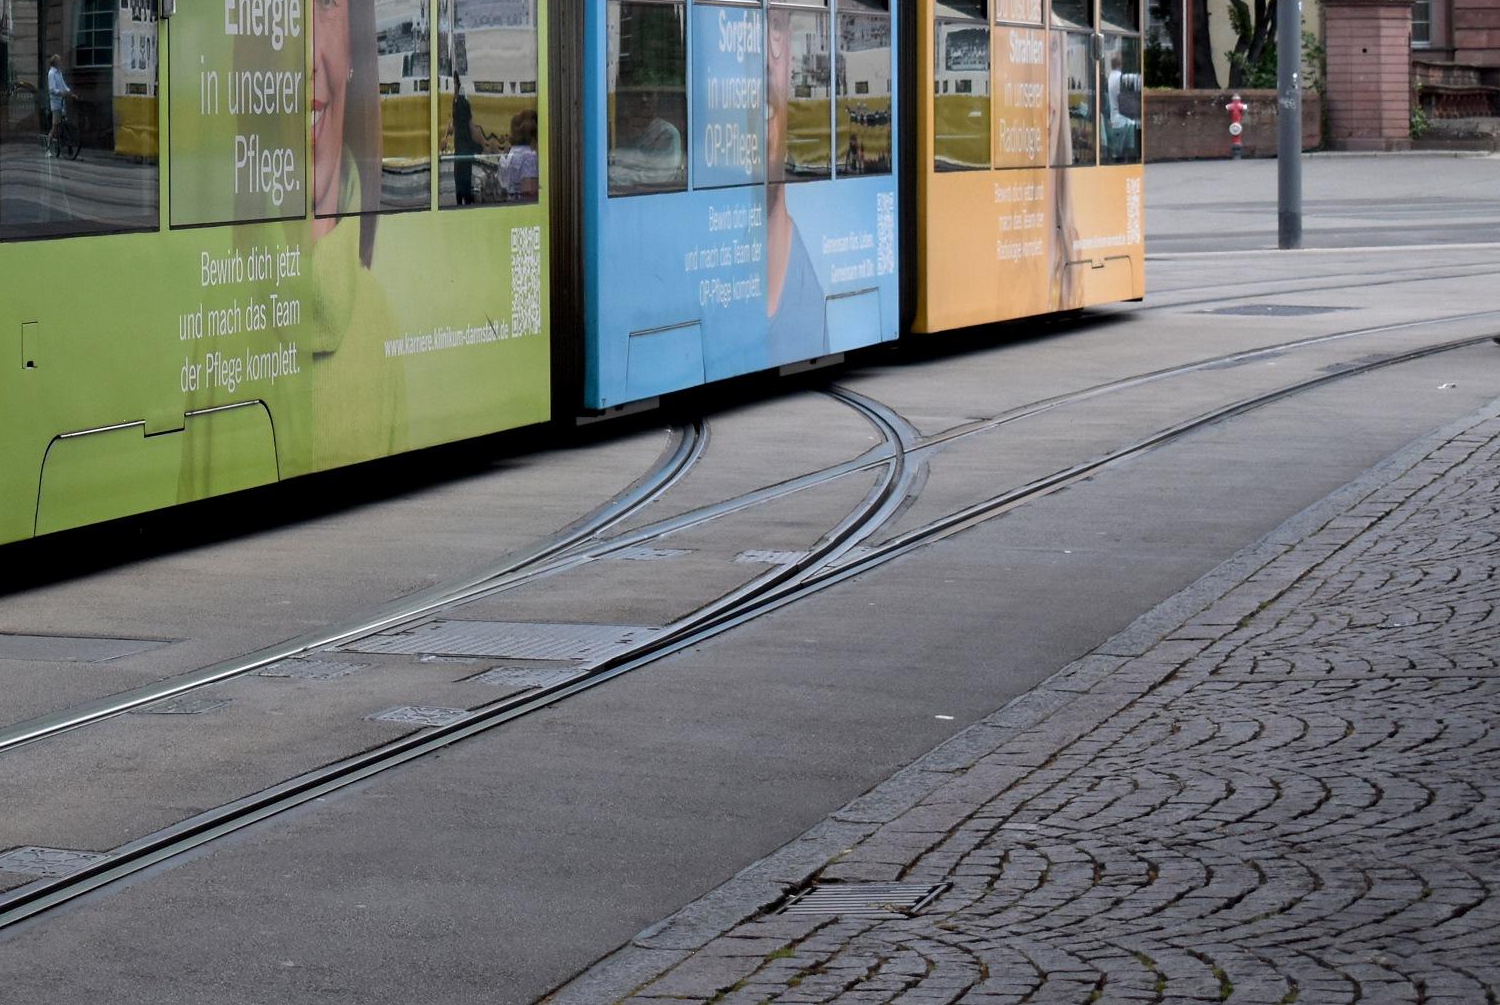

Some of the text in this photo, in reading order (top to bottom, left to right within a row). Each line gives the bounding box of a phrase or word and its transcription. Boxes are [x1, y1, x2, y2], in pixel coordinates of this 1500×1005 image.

[719, 9, 760, 62] Sorgfalt
[1010, 29, 1043, 64] Strahlen
[201, 55, 301, 115] in unserer
[708, 67, 760, 109] in unserer
[1014, 83, 1044, 108] unserer
[234, 134, 300, 206] Pflege.
[705, 123, 760, 175] OP-Pflege.
[201, 244, 301, 287] Bewirb dich jetzt
[179, 294, 300, 340] und mach das Team
[384, 319, 508, 357] www.karriere.klinikum-darmstadt.de
[180, 342, 300, 393] der Pflege komplett.
